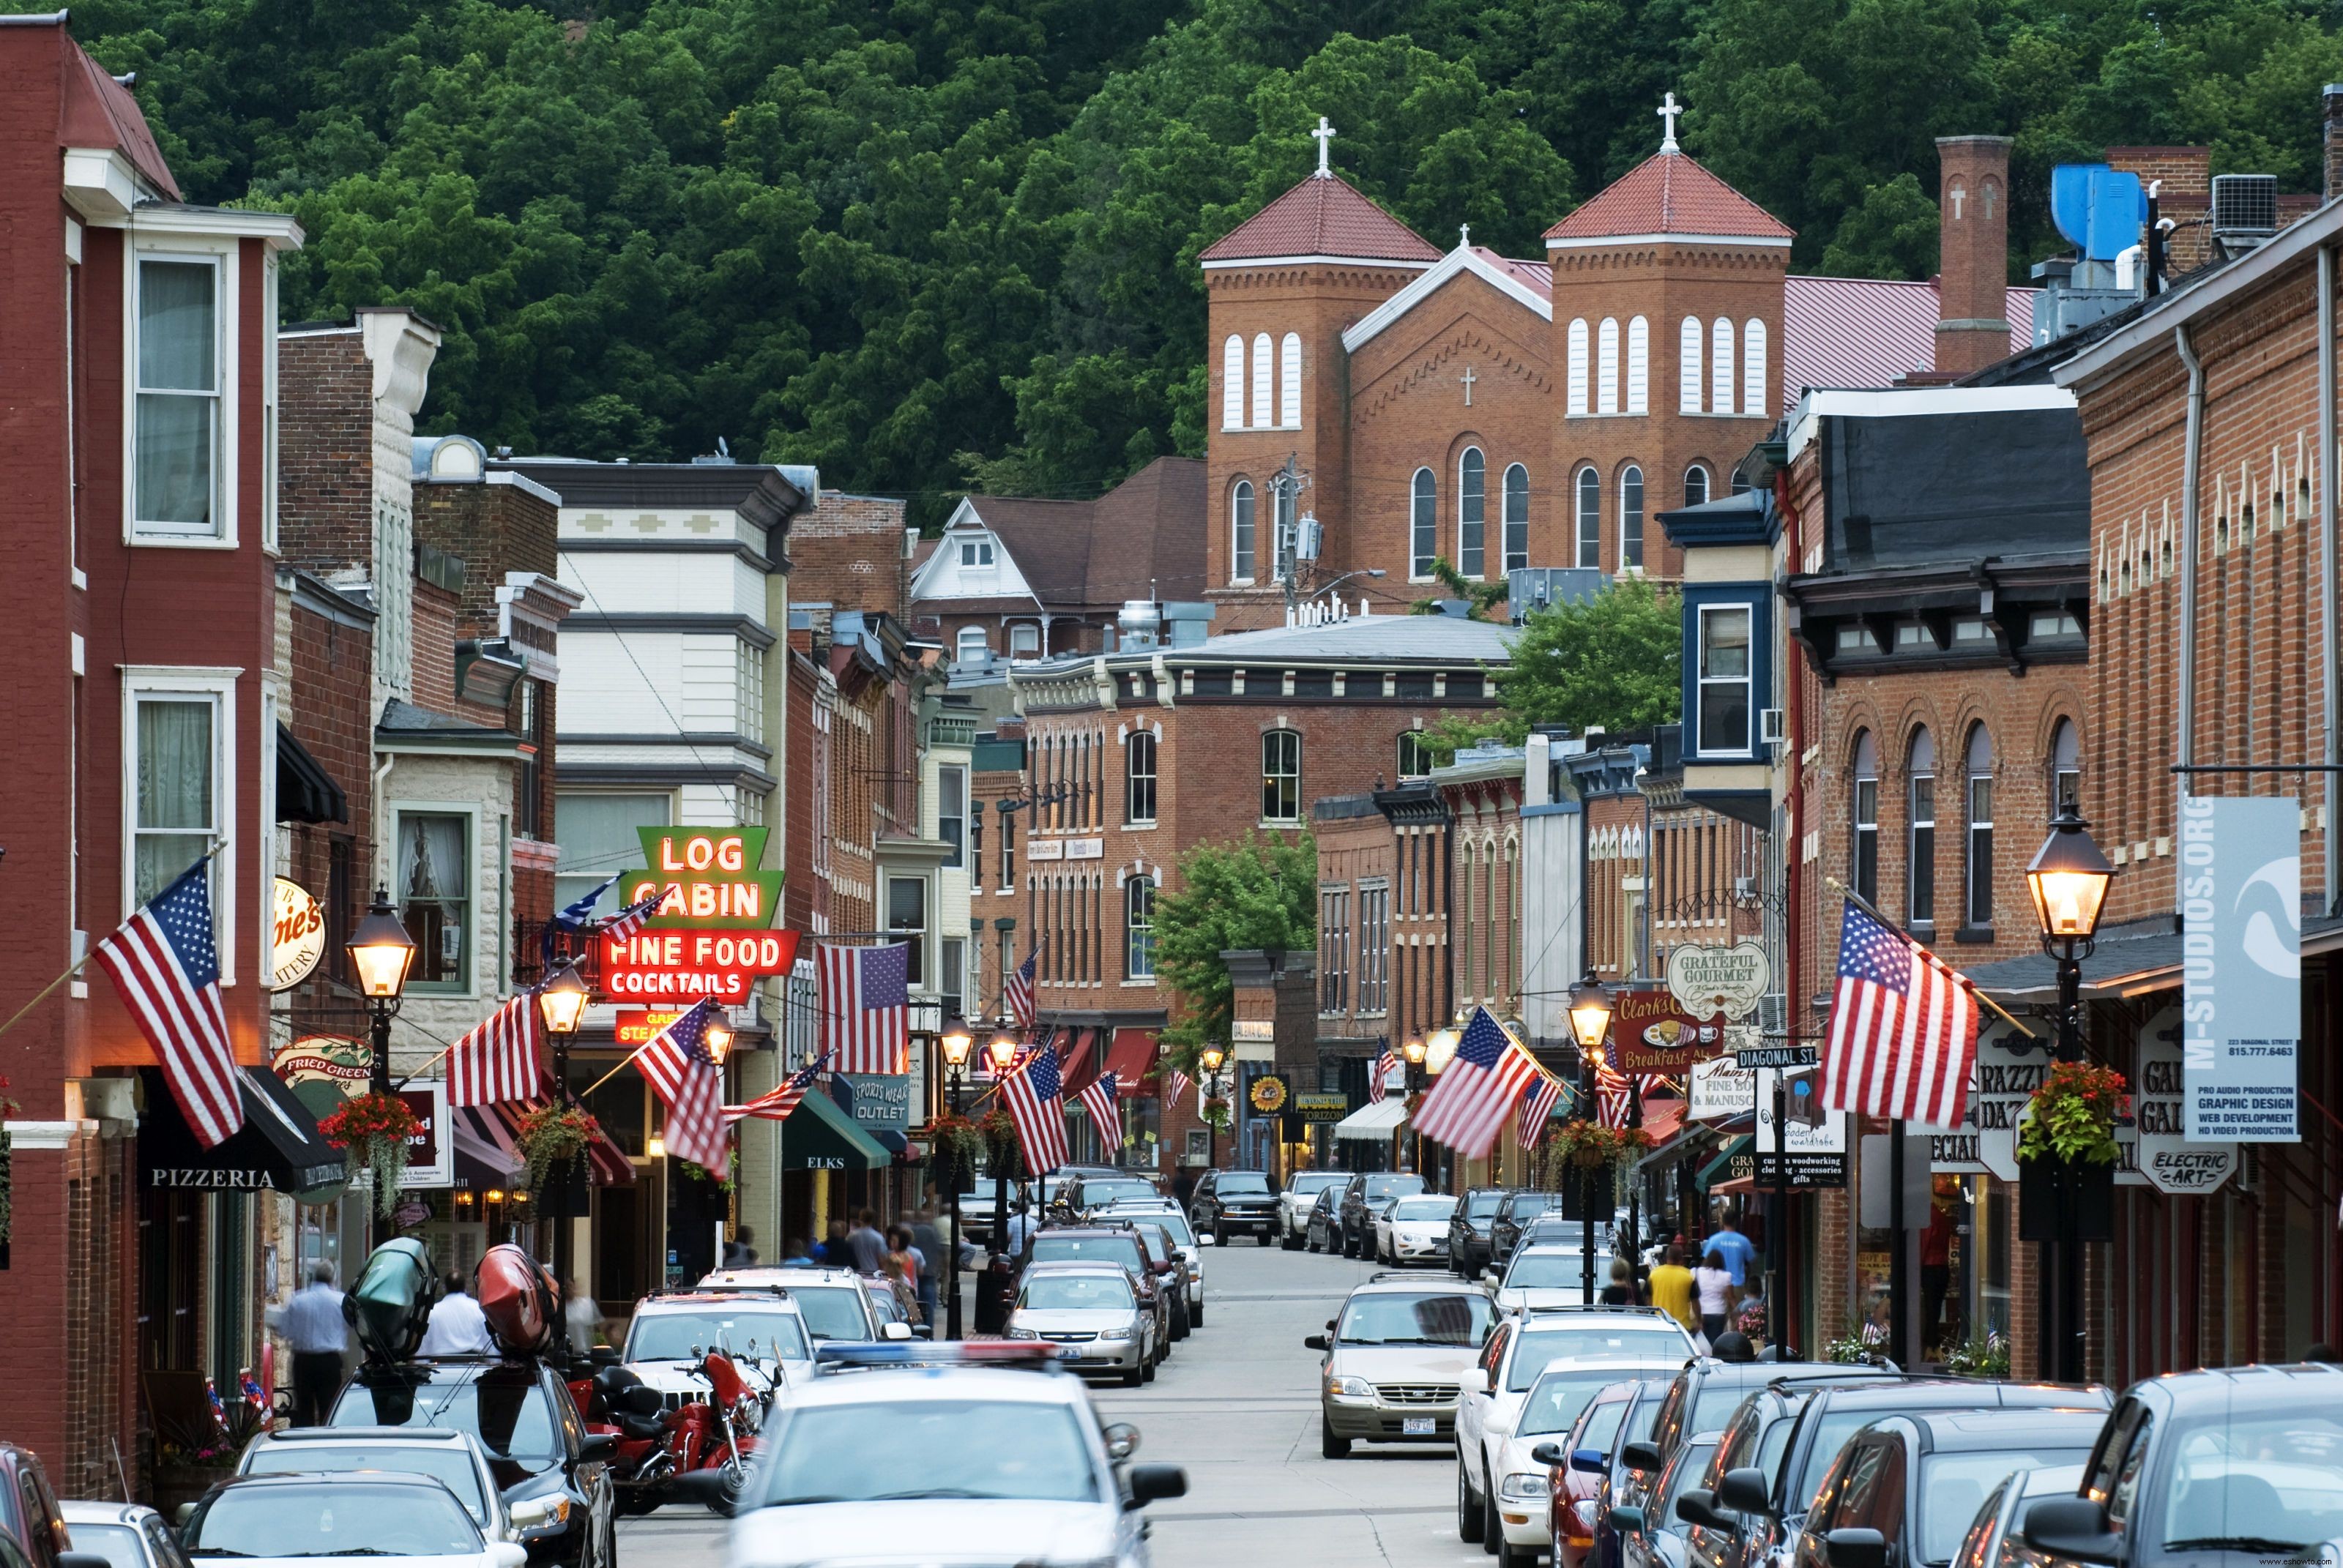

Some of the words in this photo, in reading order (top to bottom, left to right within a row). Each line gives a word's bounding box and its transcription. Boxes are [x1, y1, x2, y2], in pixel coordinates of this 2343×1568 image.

[662, 837, 743, 871] LOG
[275, 885, 294, 903] UB
[634, 881, 759, 918] CABIN
[2183, 797, 2215, 1069] M-STUDIOS.ORG
[611, 936, 682, 966] FINE
[695, 937, 780, 967] FOOD
[275, 944, 316, 984] ATERY
[1680, 955, 1758, 970] GRATEFUL
[1684, 968, 1754, 983] GOURMET
[611, 973, 741, 994] COCKTAILS
[1620, 995, 1669, 1020] Clark's
[647, 1014, 679, 1024] GRE
[620, 1027, 660, 1041] STEA
[1625, 1048, 1688, 1069] Breakfast
[1740, 1049, 1796, 1067] DIAGONAL
[1800, 1048, 1815, 1064] ST.
[2229, 1048, 2293, 1056] 815.777.6463
[287, 1059, 326, 1071] FRIED
[327, 1064, 371, 1078] GREEN
[1697, 1060, 1744, 1080] Main
[1705, 1080, 1732, 1091] FINE
[2142, 1061, 2185, 1095] GAL
[855, 1082, 883, 1102] SPORTS
[884, 1083, 908, 1105] WEAR
[2198, 1086, 2215, 1094] PRO
[2216, 1086, 2240, 1094] AUDIO
[2243, 1086, 2294, 1094] PRODUCTION
[1299, 1097, 1327, 1105] BEYOND
[1329, 1097, 1344, 1105] THE
[1694, 1095, 1701, 1106] &
[1705, 1095, 1754, 1106] MANUSC
[2198, 1099, 2249, 1109] GRAPHIC
[2251, 1099, 2294, 1109] DESIGN
[857, 1106, 906, 1120] OUTLET
[2139, 1101, 2185, 1135] GAL
[2199, 1113, 2220, 1123] WEB
[2224, 1113, 2293, 1123] DEVELOPMENT
[2198, 1127, 2210, 1135] HD
[2213, 1127, 2238, 1135] VIDEO
[2240, 1127, 2294, 1135] PRODUCTION
[1791, 1134, 1834, 1146] wardrobe
[808, 1157, 844, 1169] ELKS
[1731, 1156, 1754, 1166] GRA
[1792, 1157, 1840, 1166] woodworking
[2154, 1154, 2227, 1169] ELECTRIC
[1799, 1166, 1841, 1174] accessories
[152, 1169, 275, 1188] PIZZERIA
[1793, 1175, 1810, 1184] gifts
